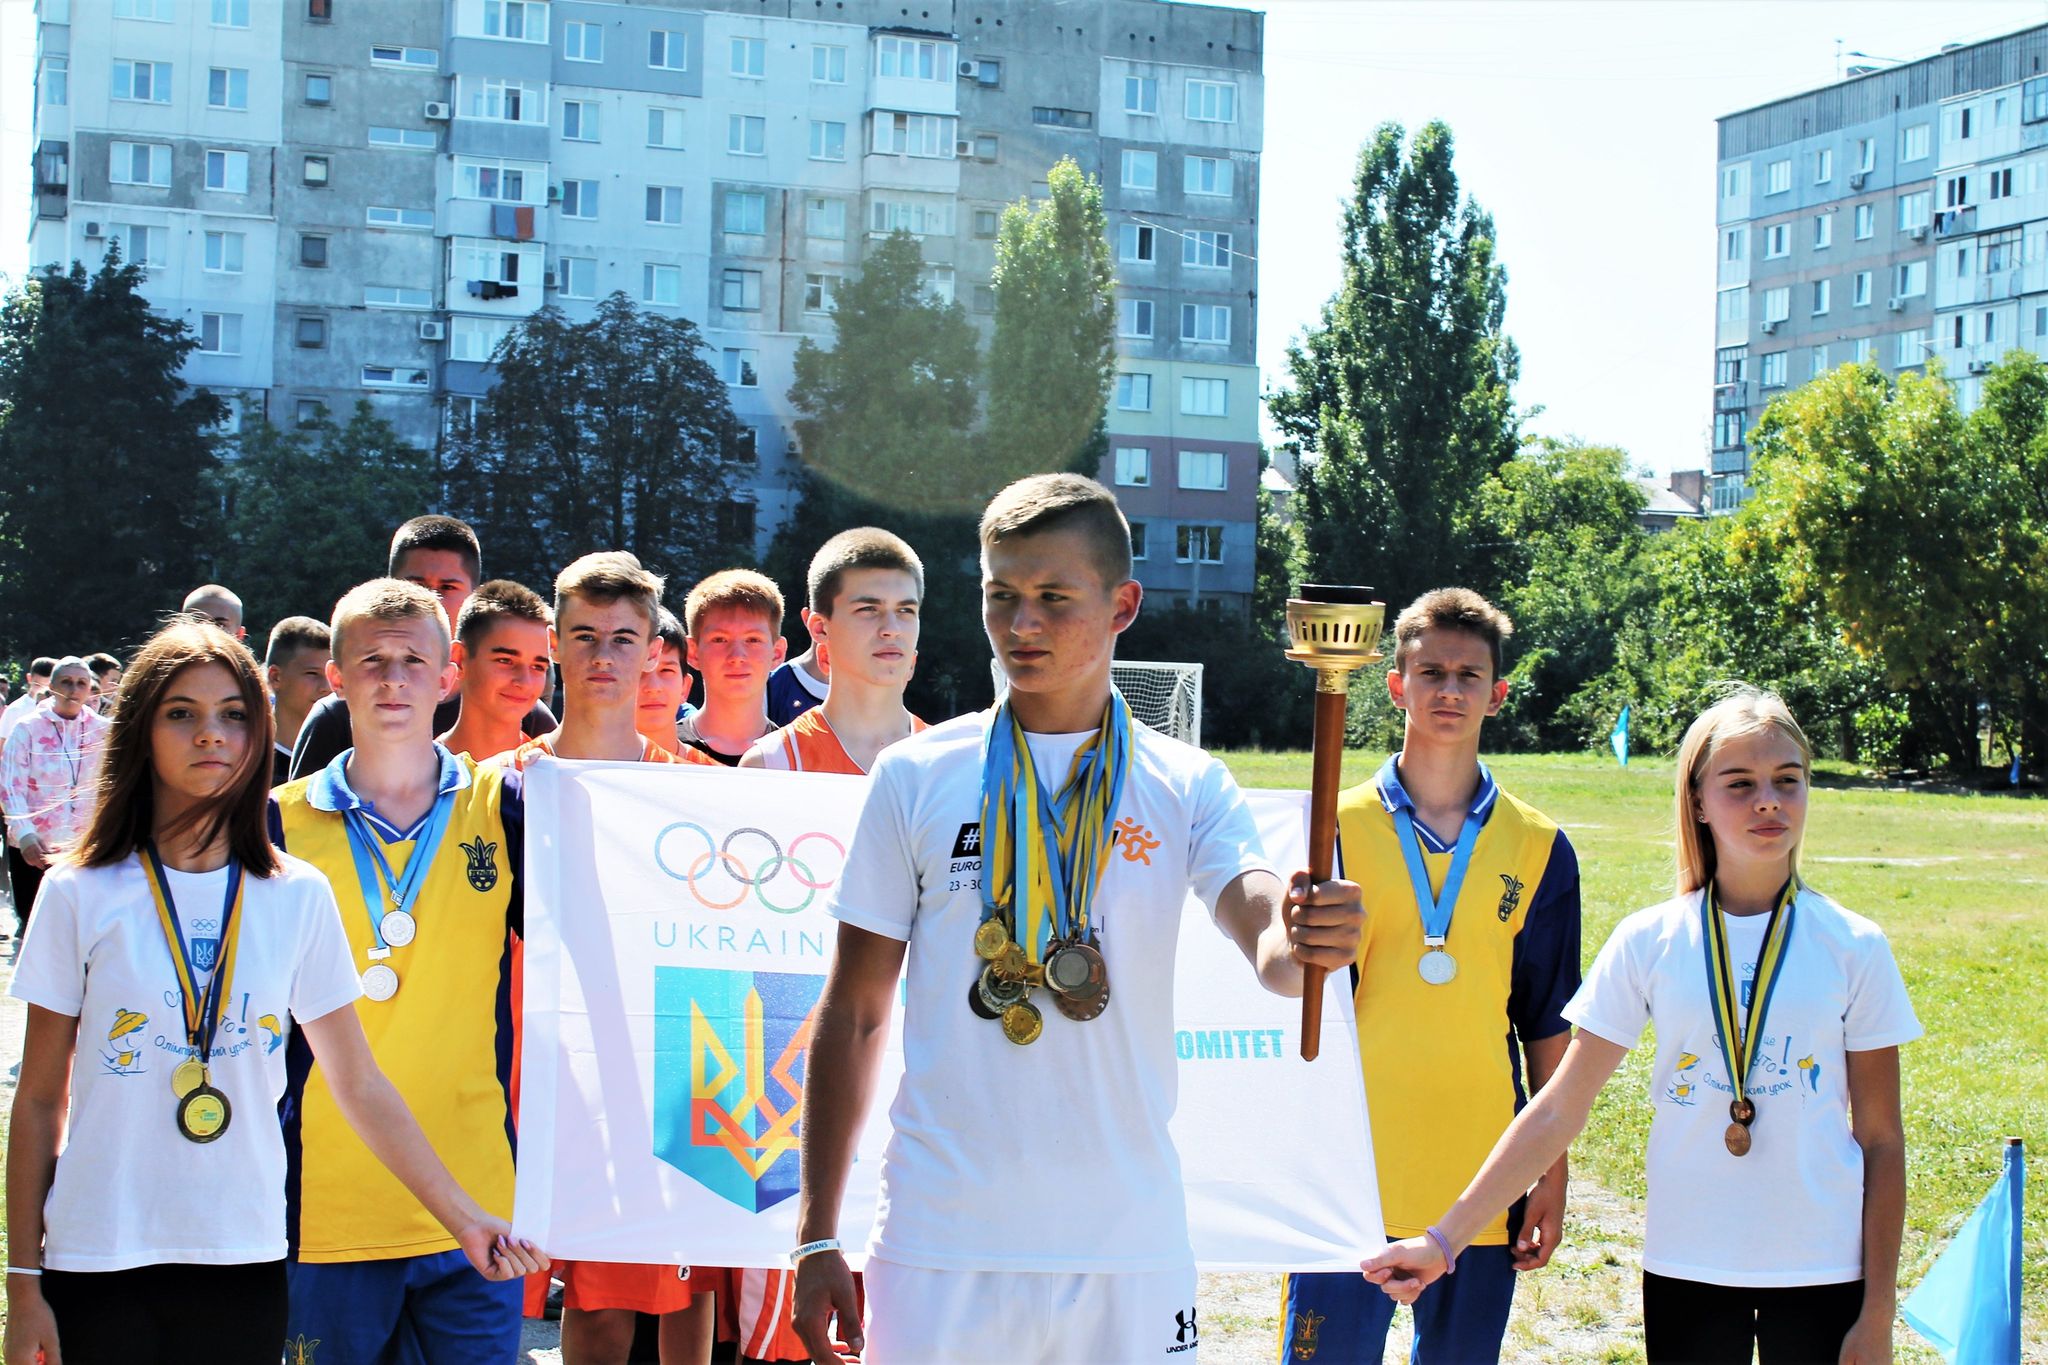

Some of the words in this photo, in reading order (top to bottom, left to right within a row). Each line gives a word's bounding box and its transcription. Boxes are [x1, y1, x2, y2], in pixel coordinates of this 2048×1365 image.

[950, 860, 982, 873] EURO
[949, 880, 960, 892] 23
[654, 921, 823, 957] UKRAIN
[1175, 1029, 1284, 1060] ОМІТЕТ
